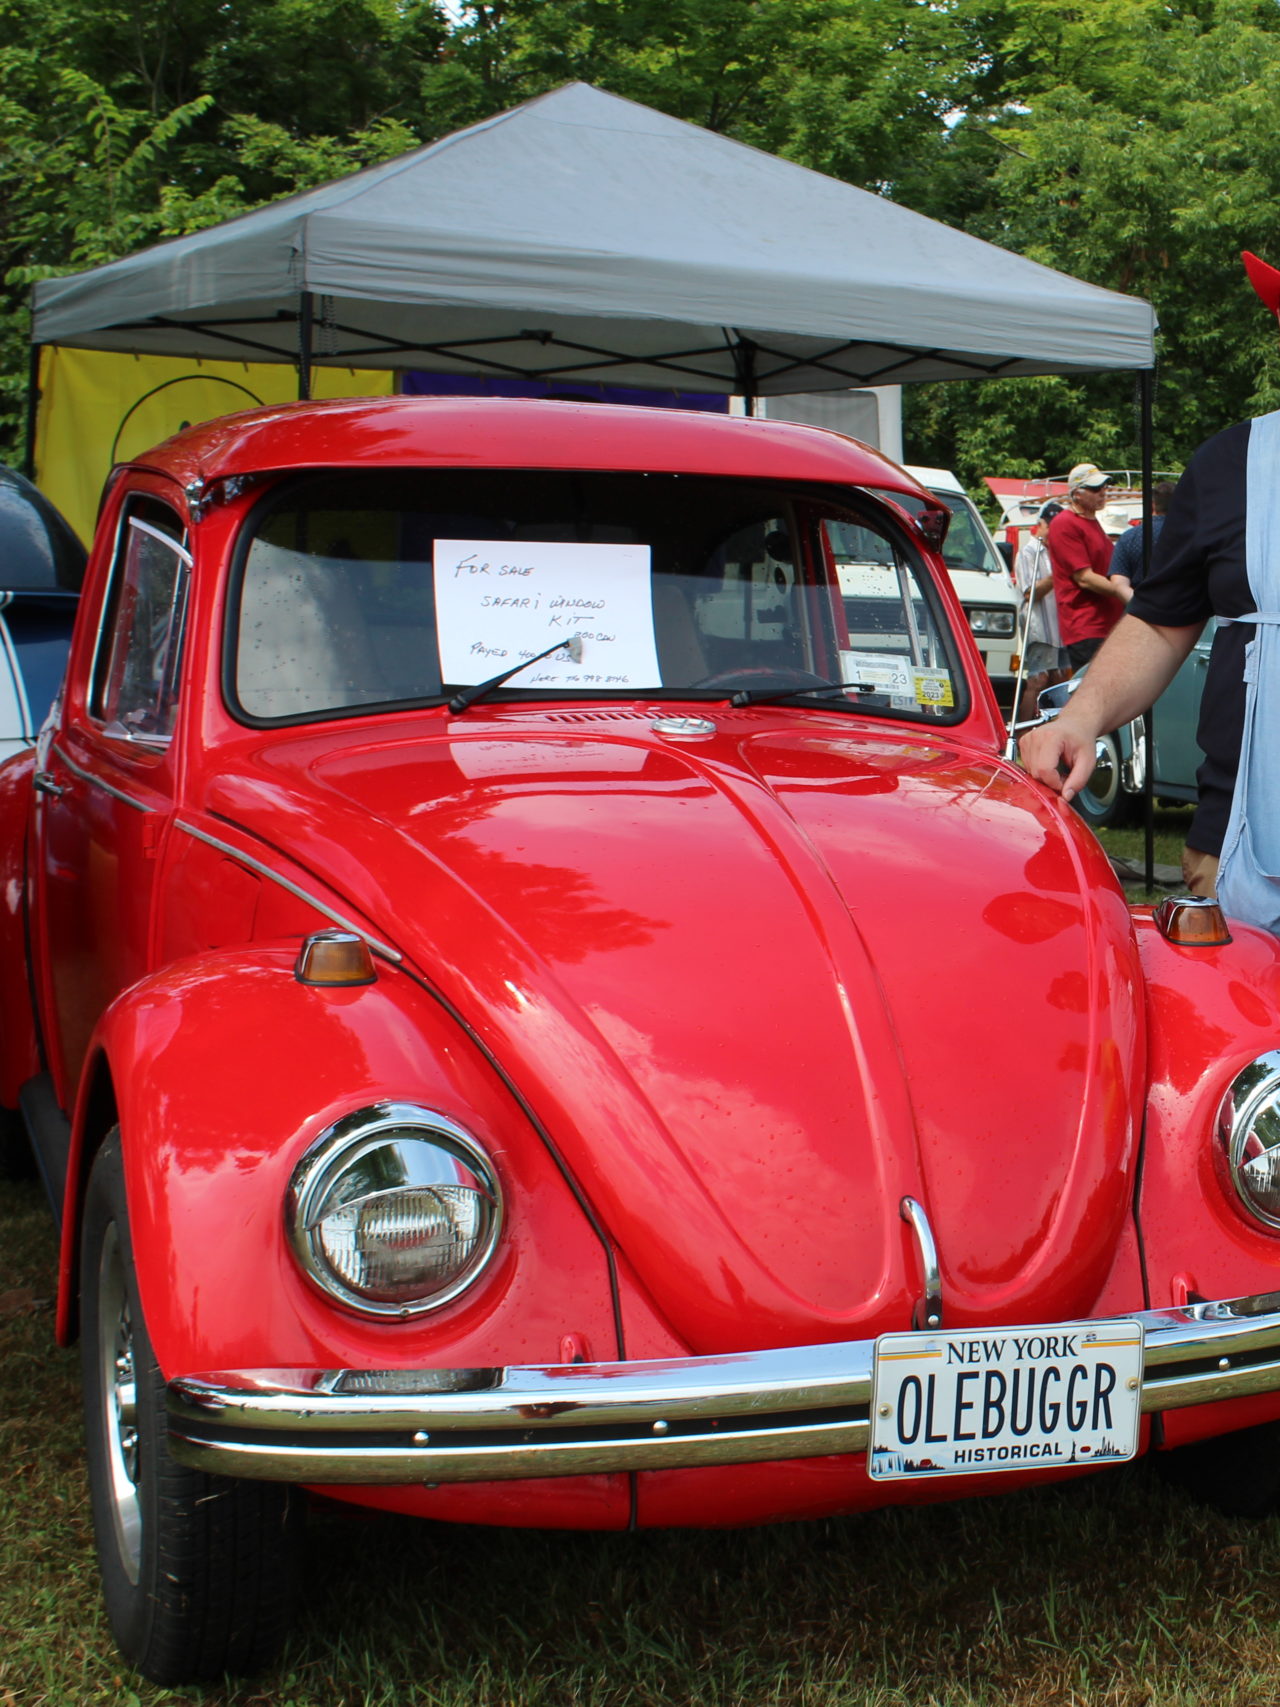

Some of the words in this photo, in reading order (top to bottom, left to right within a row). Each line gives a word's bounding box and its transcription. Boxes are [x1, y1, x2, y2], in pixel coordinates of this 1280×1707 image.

[454, 554, 490, 578] FOR
[498, 564, 535, 577] SALE
[470, 641, 508, 658] PAYED
[891, 672, 908, 685] 23
[921, 690, 940, 699] 2023
[946, 1336, 1006, 1365] NEW
[1012, 1334, 1079, 1361] YORK
[896, 1362, 1118, 1445] OLEBUGGR
[953, 1441, 1063, 1464] HISTORICAL
